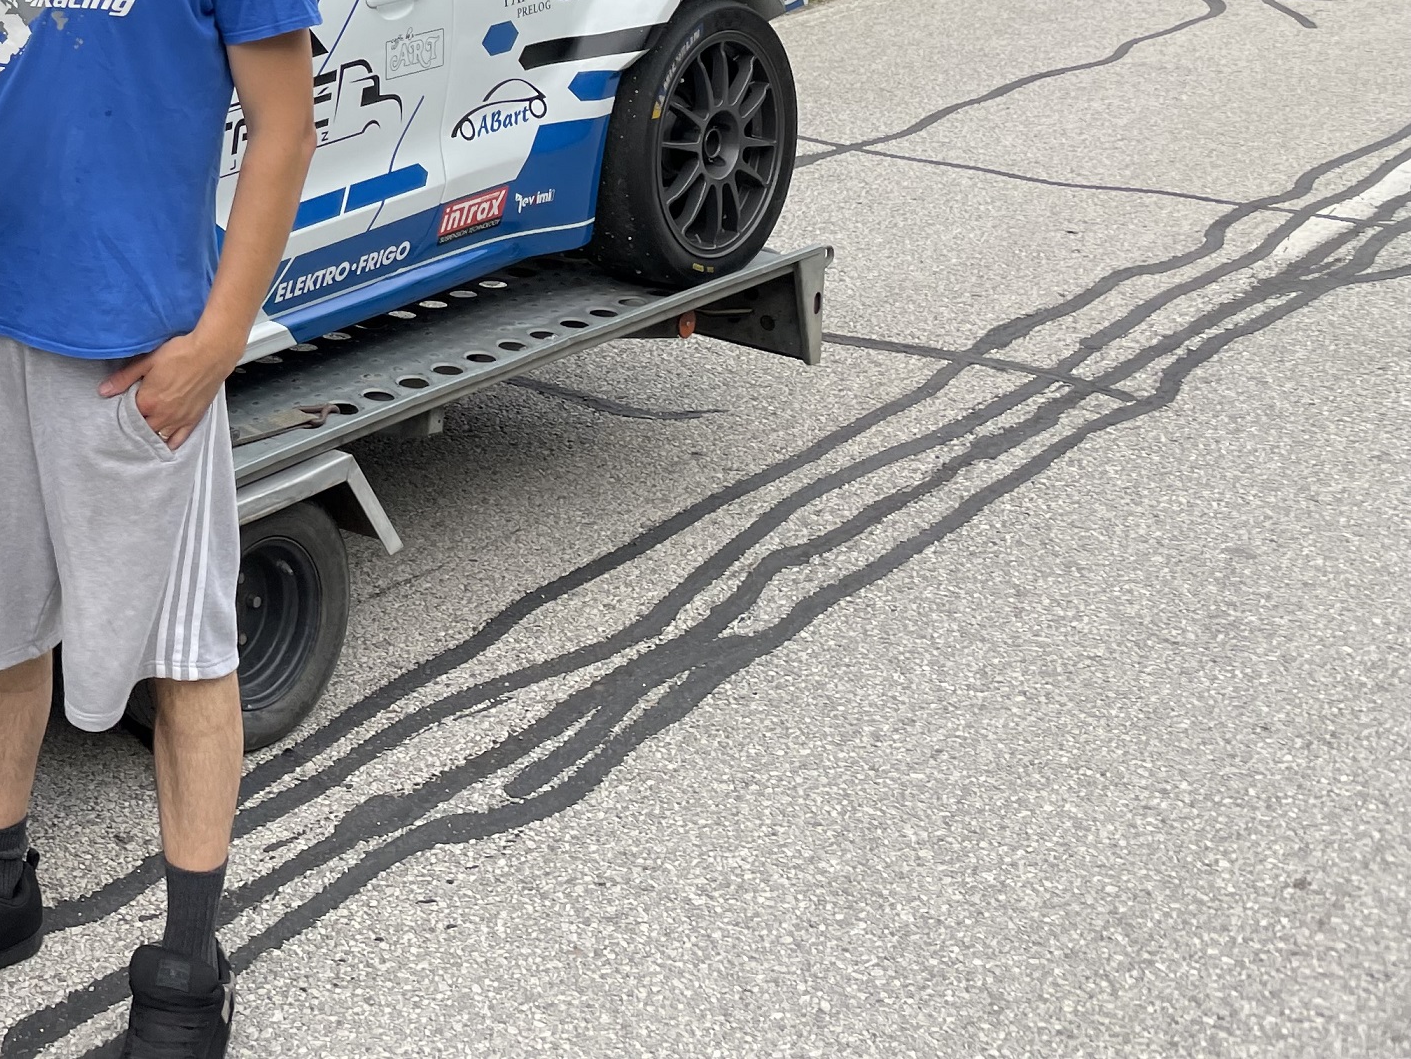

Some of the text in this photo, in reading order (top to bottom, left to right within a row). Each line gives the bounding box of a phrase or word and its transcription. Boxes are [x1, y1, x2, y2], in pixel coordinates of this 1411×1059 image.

[516, 0, 552, 18] PRELOG
[389, 35, 441, 72] ART
[476, 106, 530, 138] ABart
[440, 189, 506, 233] inTrax
